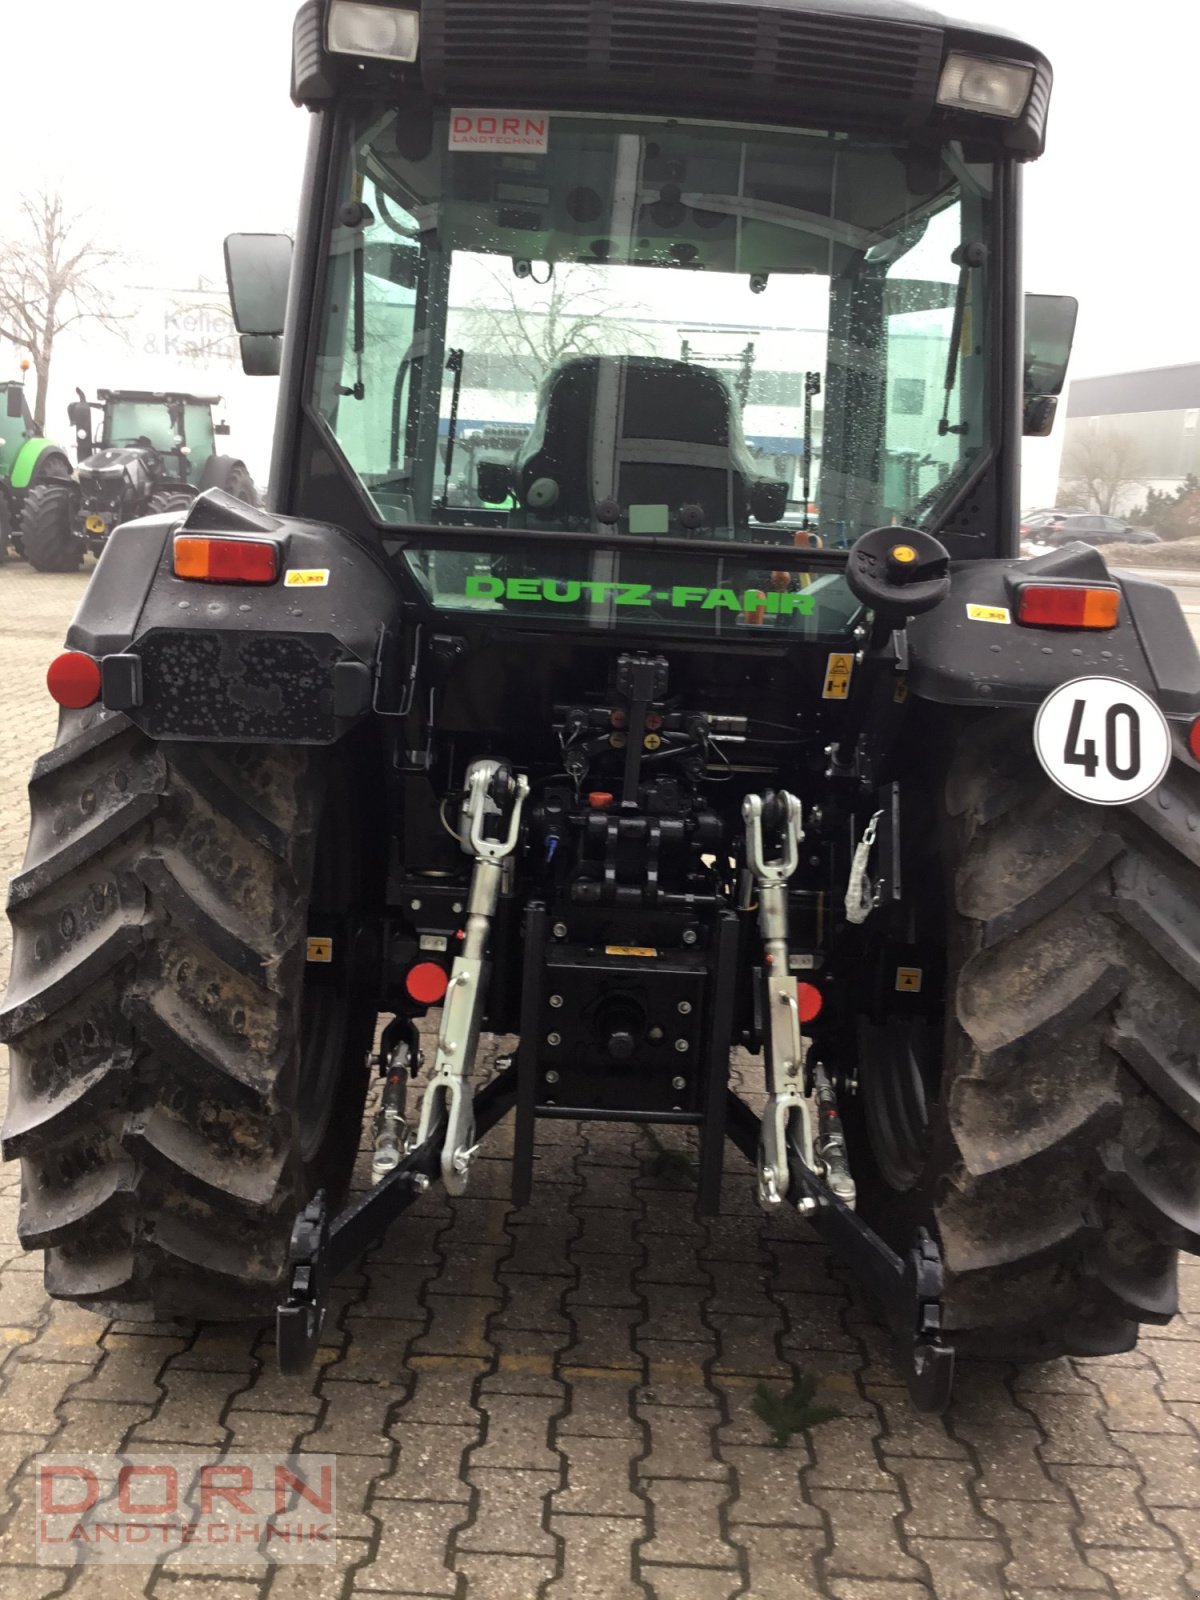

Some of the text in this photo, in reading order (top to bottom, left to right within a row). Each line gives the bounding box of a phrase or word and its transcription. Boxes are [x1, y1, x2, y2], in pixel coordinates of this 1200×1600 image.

[453, 116, 545, 136] DORN
[452, 135, 544, 146] LANDTECHNIK
[143, 332, 160, 354] &
[465, 576, 816, 616] DEUTZ-FAHR
[1063, 699, 1141, 781] 40
